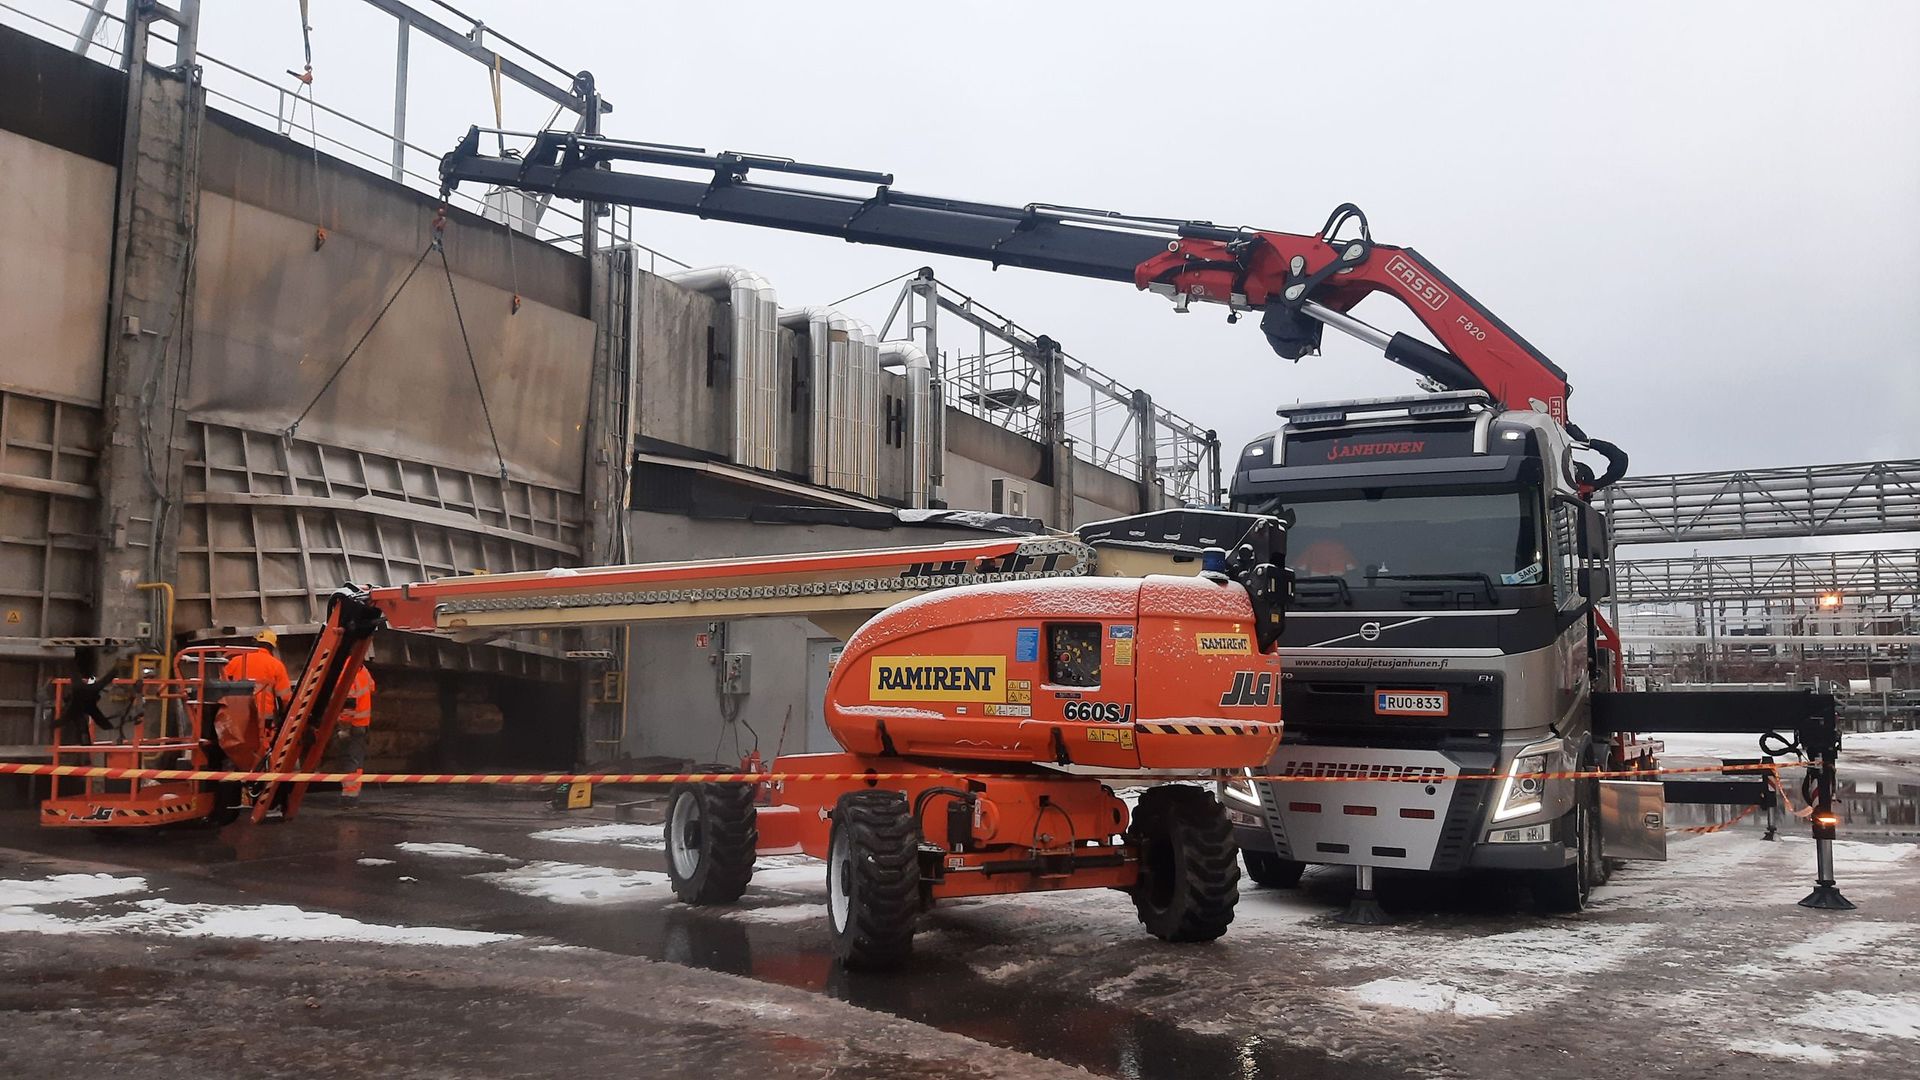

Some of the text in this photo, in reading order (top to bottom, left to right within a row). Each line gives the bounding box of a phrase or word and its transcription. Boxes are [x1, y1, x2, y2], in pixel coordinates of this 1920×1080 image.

[1391, 261, 1442, 305] FASSI
[1456, 315, 1486, 341] F820
[1518, 565, 1538, 580] SAKU
[1295, 658, 1449, 670] www.nostojakuljetusjanhunen.fi
[877, 666, 996, 691] RAMIRENT
[1219, 670, 1273, 707] JLG
[1064, 701, 1132, 723] 660SJ
[1388, 696, 1442, 710] RUO-833
